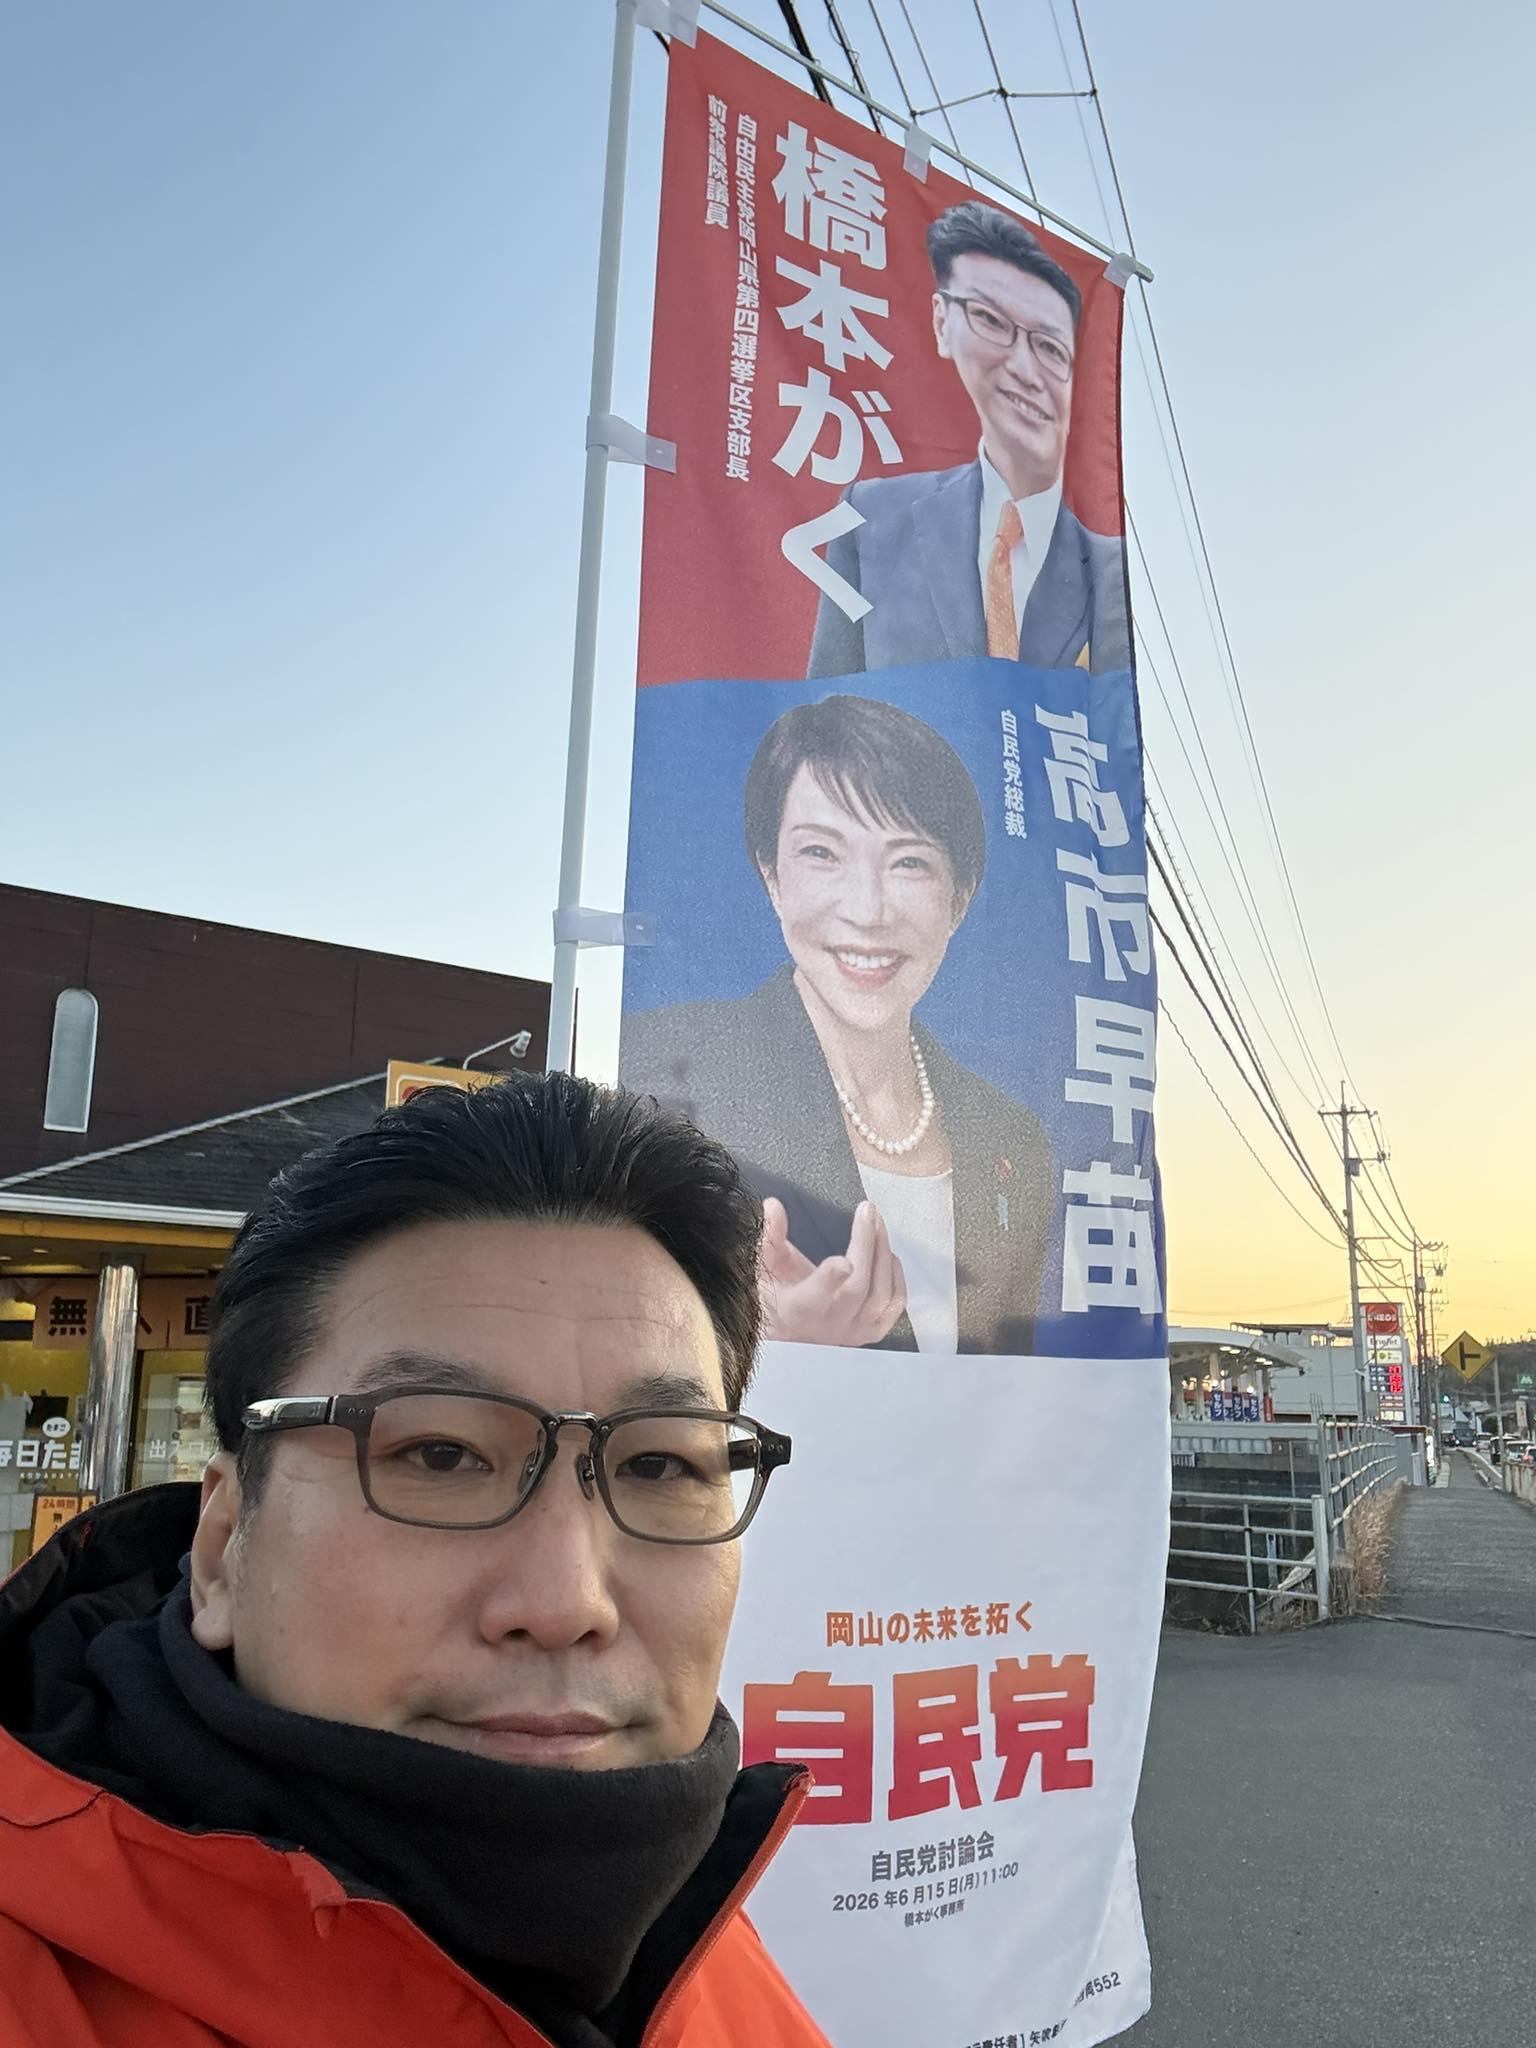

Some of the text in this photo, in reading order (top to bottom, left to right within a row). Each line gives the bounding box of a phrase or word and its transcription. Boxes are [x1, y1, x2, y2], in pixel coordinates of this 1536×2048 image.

[705, 94, 730, 230] 前衆議院議員
[726, 113, 760, 483] 自由民主党岡山県第四選挙区支部長
[773, 120, 903, 623] 橋本がく
[1001, 709, 1028, 839] 自民党総裁
[826, 1601, 1034, 1648] 岡山の未来を拓く
[743, 1654, 1096, 1826] 自民党
[871, 1830, 995, 1883] 自民党討論会
[904, 1899, 966, 1928] 橋本がく事務所
